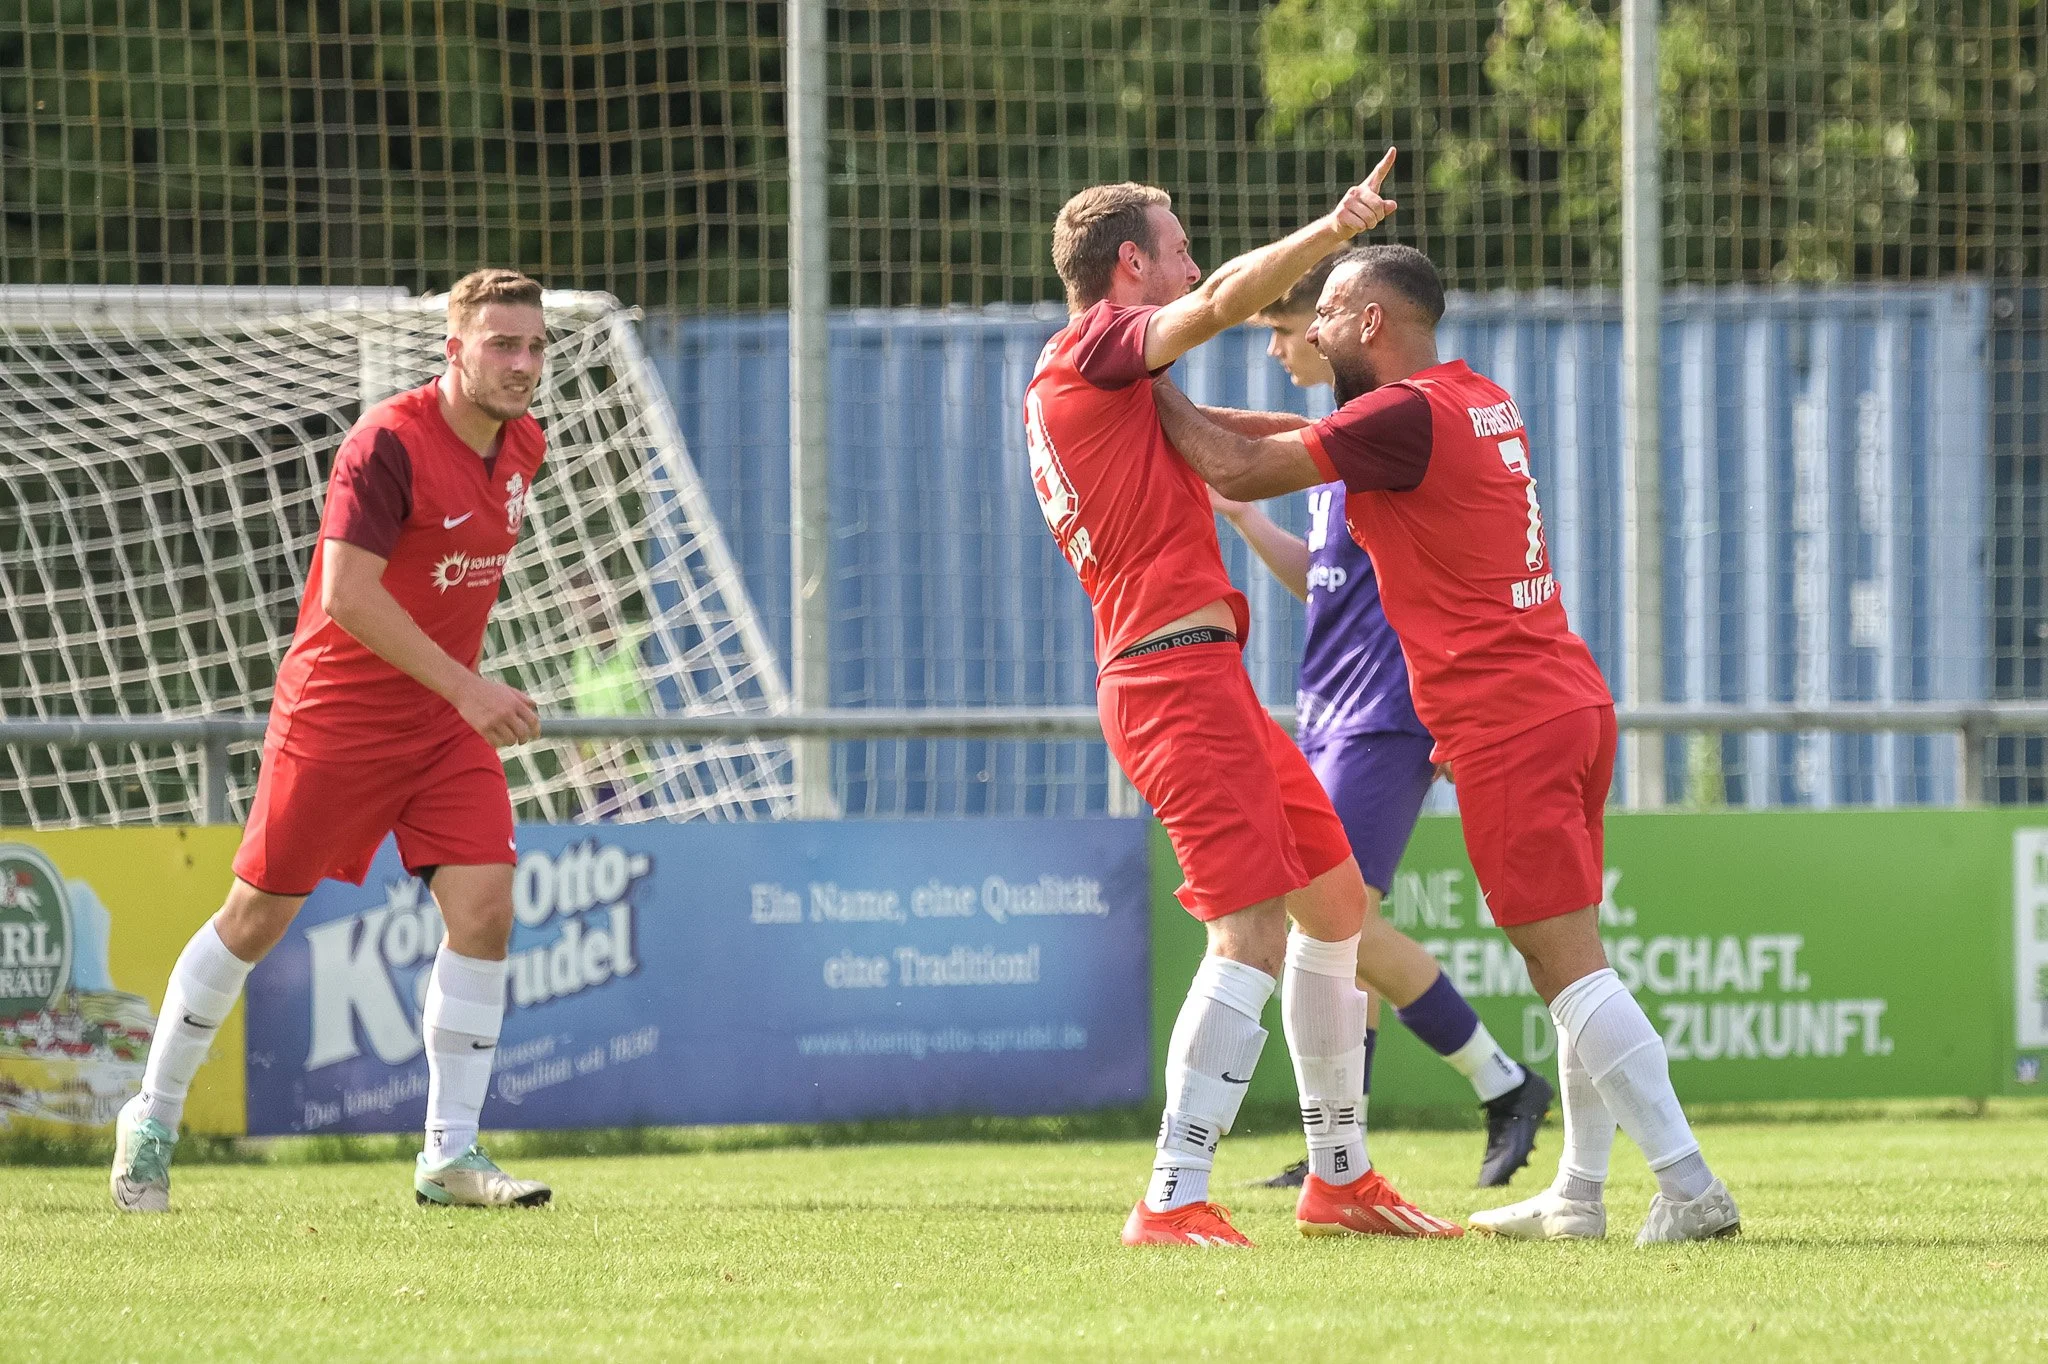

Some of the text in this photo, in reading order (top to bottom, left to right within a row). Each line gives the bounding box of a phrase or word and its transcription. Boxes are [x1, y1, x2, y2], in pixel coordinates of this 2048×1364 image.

[1498, 437, 1546, 572] 7
[1172, 631, 1212, 648] ROSSI
[512, 838, 649, 927] Otto-
[750, 873, 1109, 925] Ein Name, eine Qualität,
[0, 922, 62, 968] RL
[823, 942, 1041, 989] eine Tradition!
[1659, 997, 1894, 1061] ZUKUNFT.
